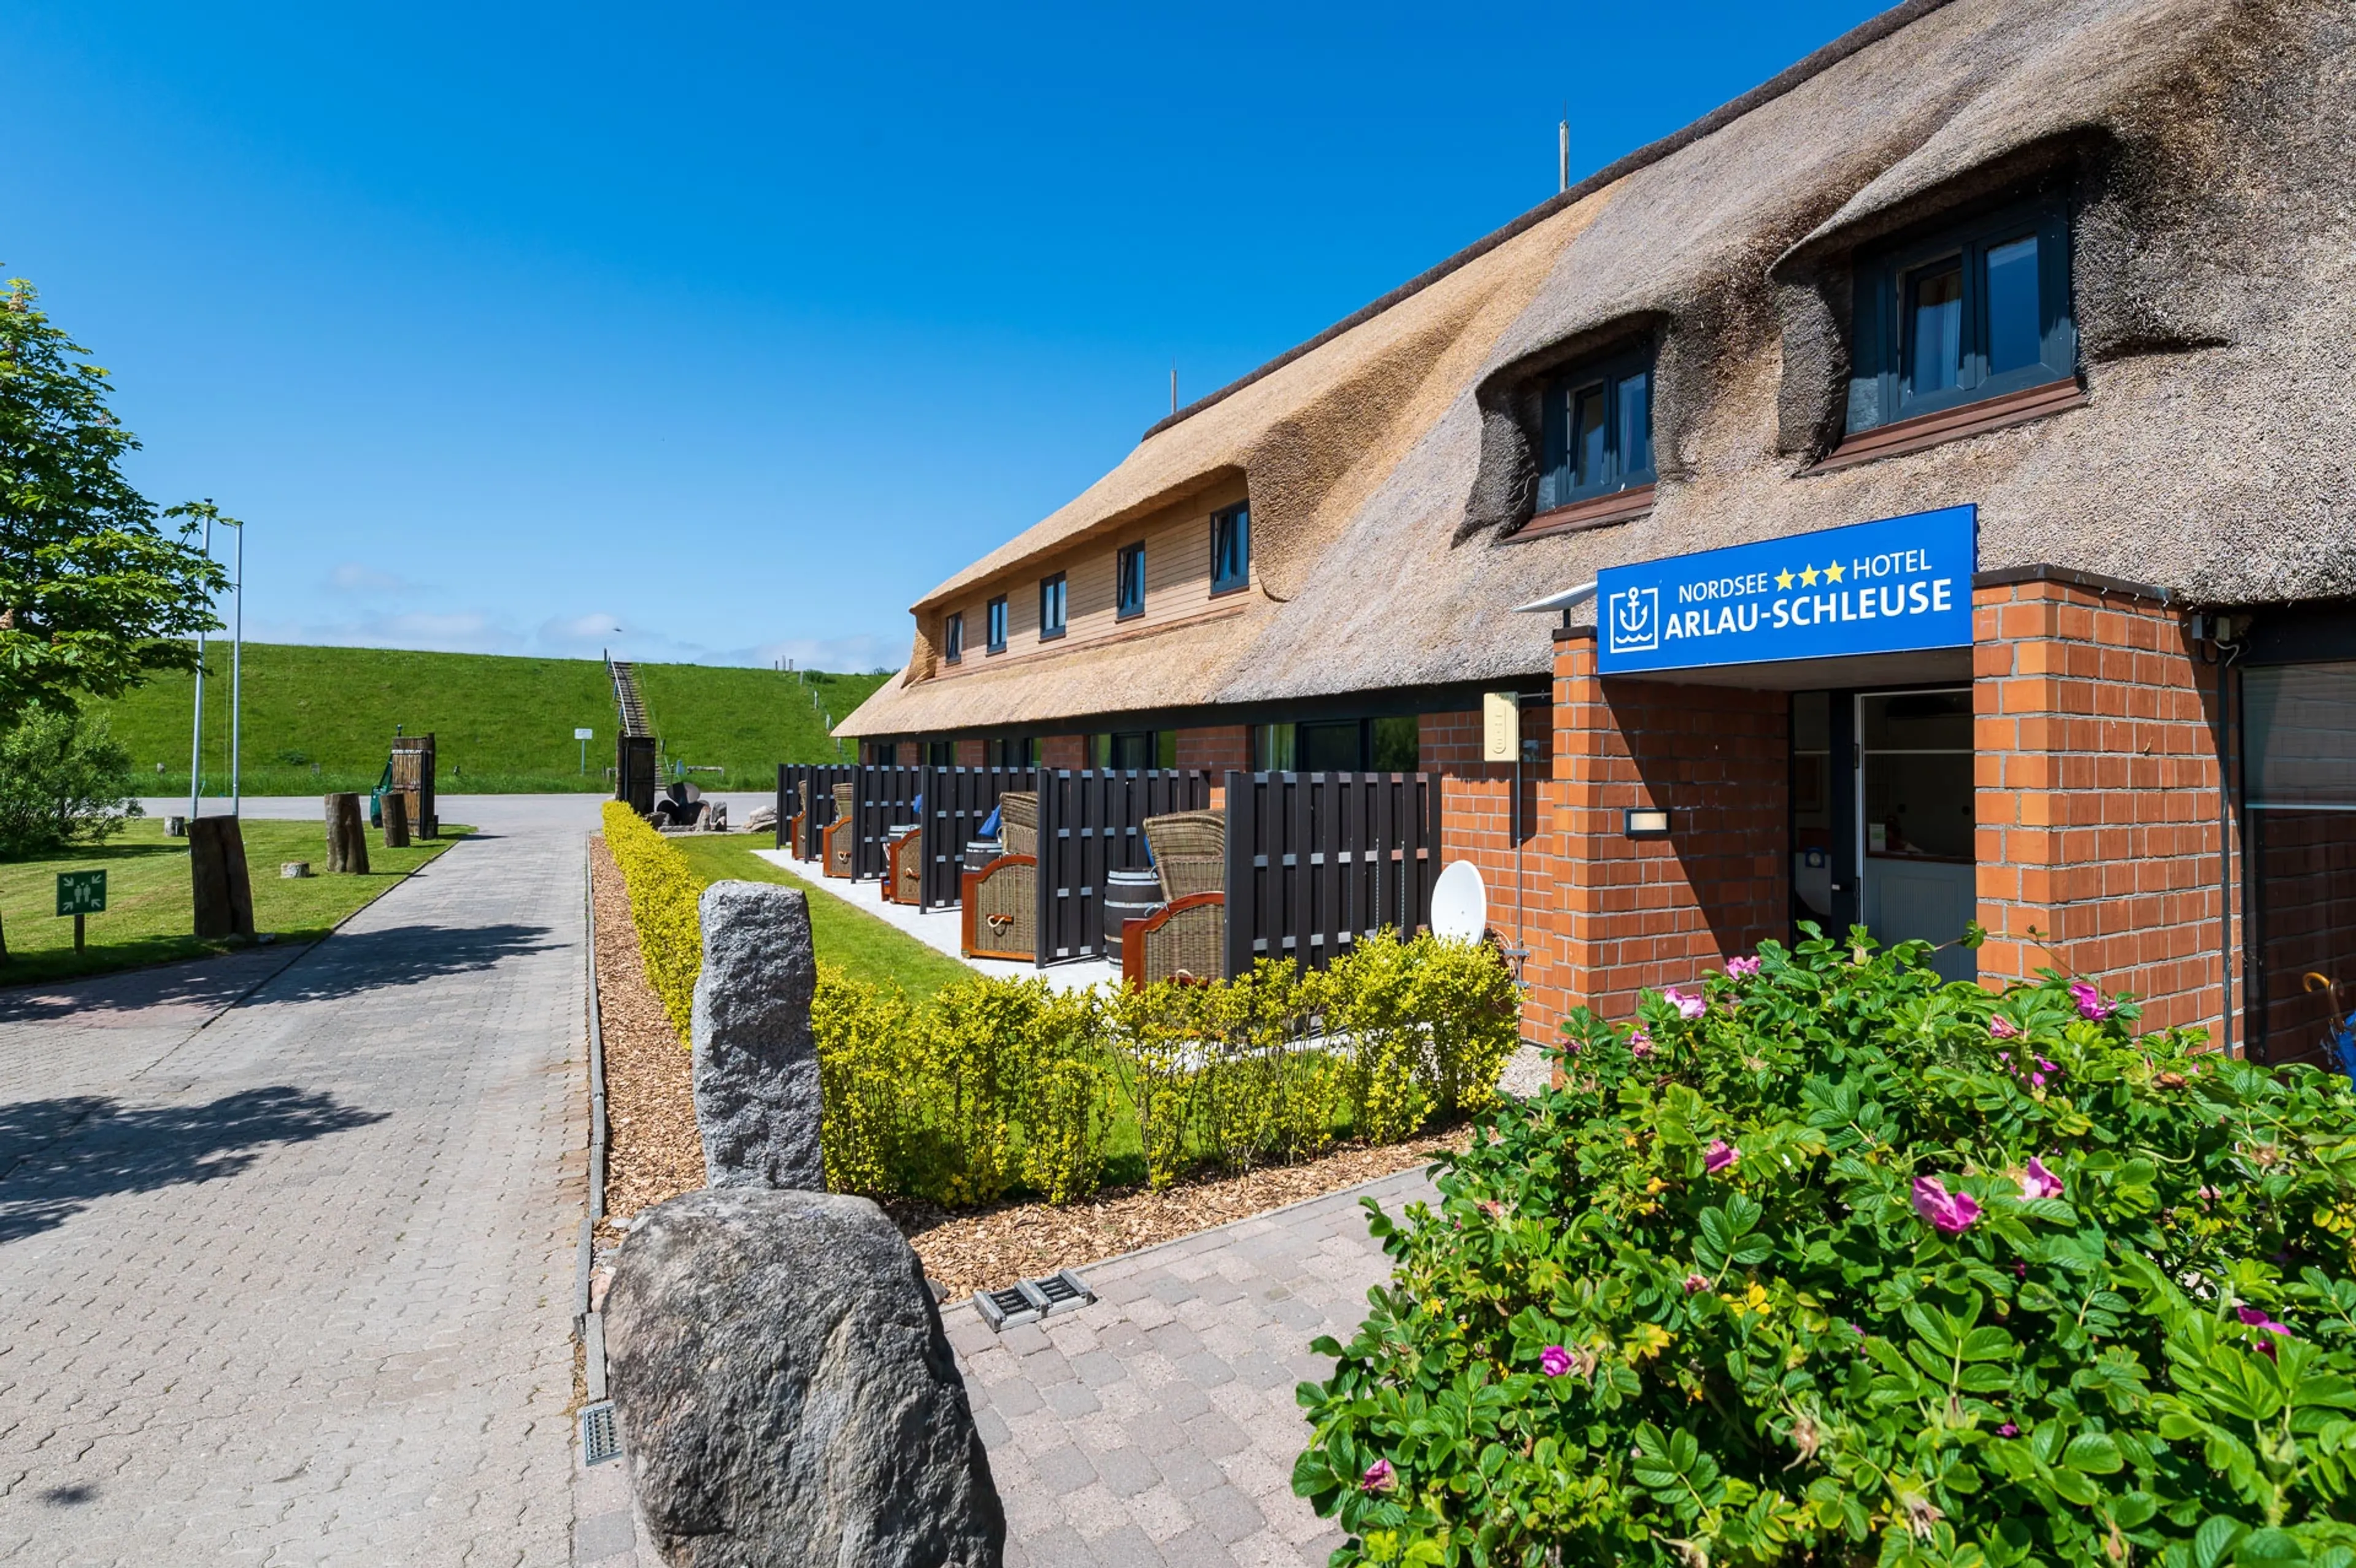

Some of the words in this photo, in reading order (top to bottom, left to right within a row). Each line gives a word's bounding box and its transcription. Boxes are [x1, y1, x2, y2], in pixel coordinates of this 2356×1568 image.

[1679, 572, 1768, 604] NORDSEE
[1854, 548, 1932, 580] HOTEL
[1665, 578, 1952, 640] ARLAU-SCHLEUSE
